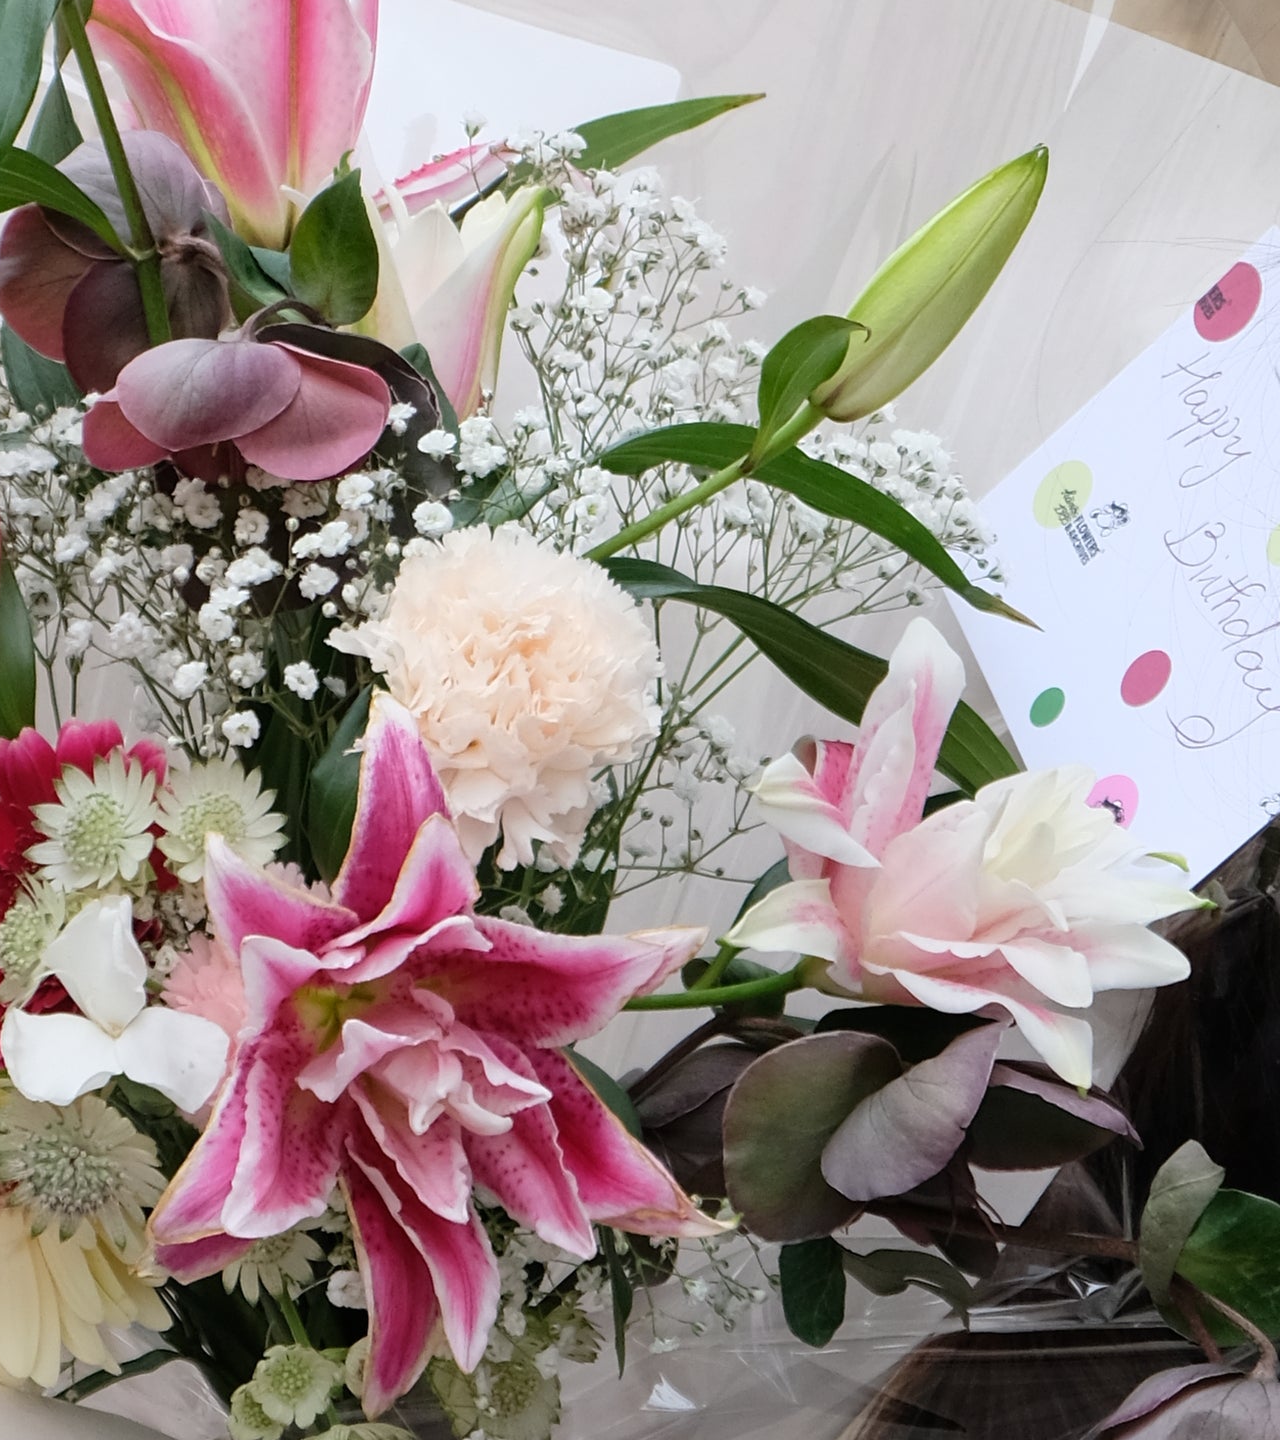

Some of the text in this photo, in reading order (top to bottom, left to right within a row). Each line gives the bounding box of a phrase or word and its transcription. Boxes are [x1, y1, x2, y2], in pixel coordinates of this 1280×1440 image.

[1161, 351, 1253, 488] Happy
[1069, 529, 1090, 566] ARCHIVES
[1073, 514, 1100, 558] FLOWERS
